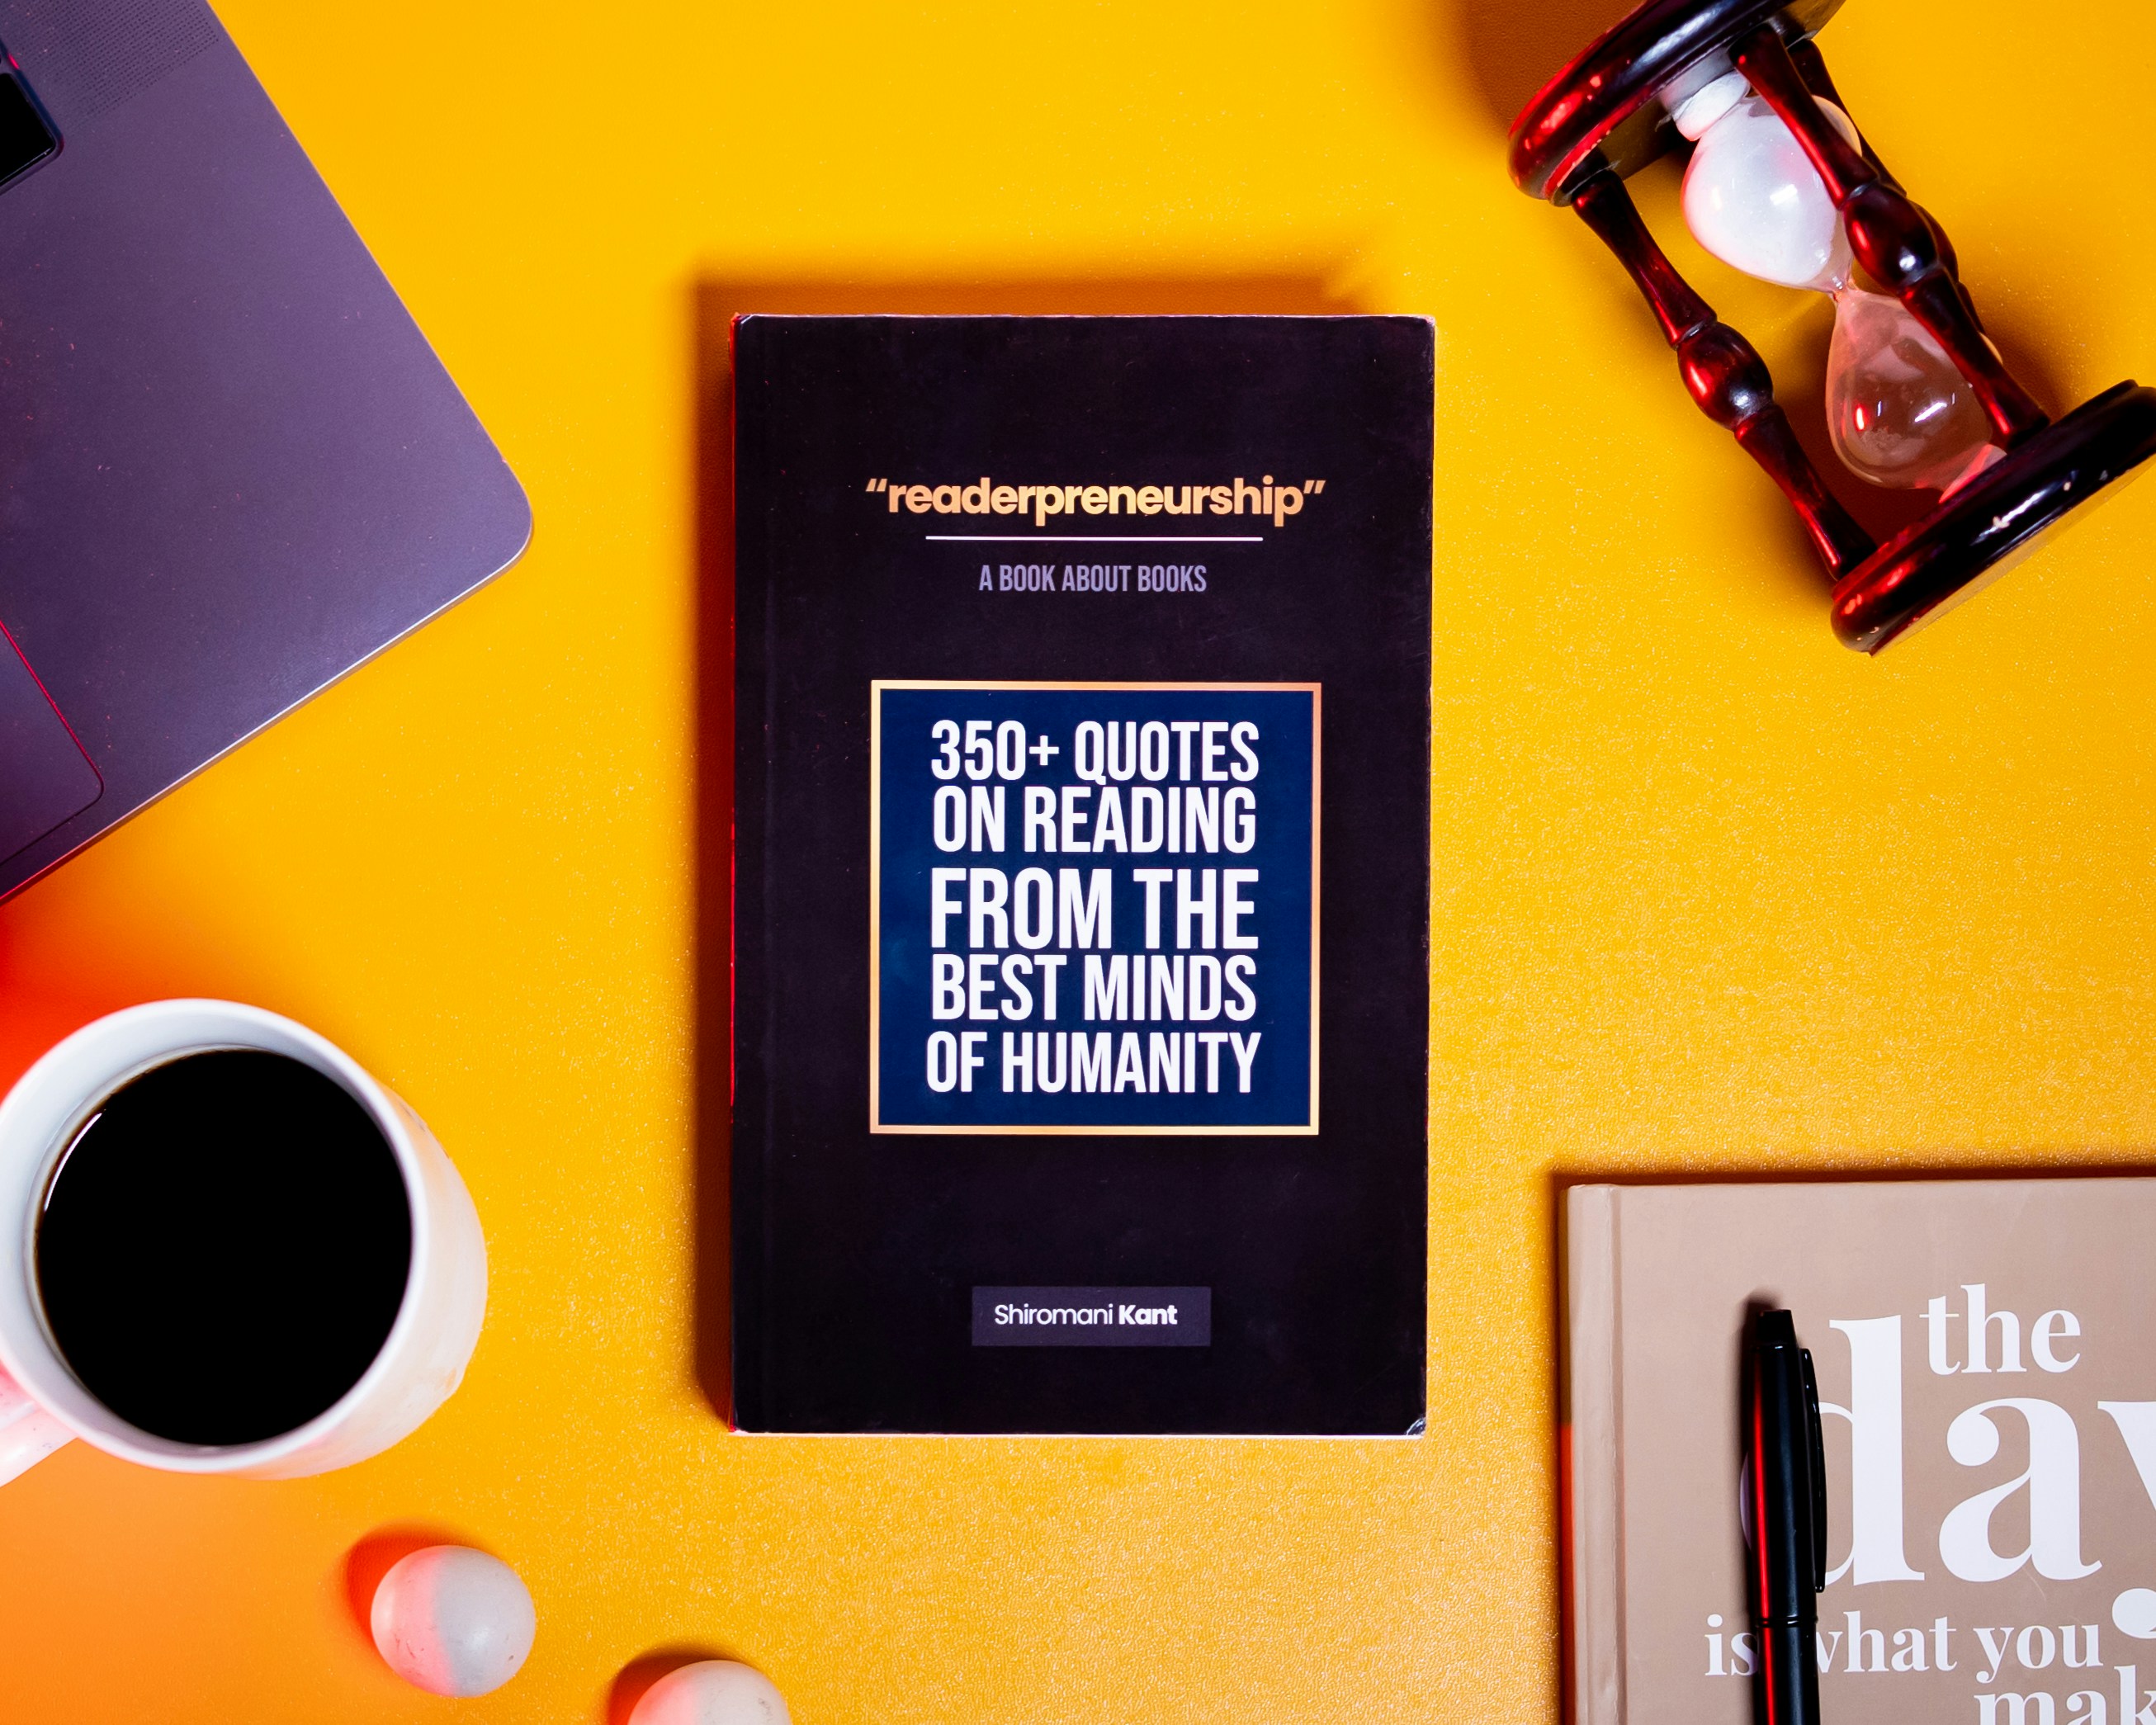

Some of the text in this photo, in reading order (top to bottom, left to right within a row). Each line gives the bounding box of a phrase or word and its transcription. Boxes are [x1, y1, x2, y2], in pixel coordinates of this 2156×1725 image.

[977, 565, 1207, 592] A BOOK ABOUT BOOKS
[931, 720, 1259, 783] 350+ QUOTES
[934, 786, 1255, 853] ON READING
[931, 867, 1258, 948] FROM THE
[932, 954, 1255, 1020] BEST MINDS
[927, 1032, 1261, 1092] OF HUMANITY
[993, 1303, 1177, 1324] Shiromani Kant
[1919, 1283, 2081, 1376] the
[1704, 1614, 1760, 1676] is
[1973, 1624, 2104, 1684] you
